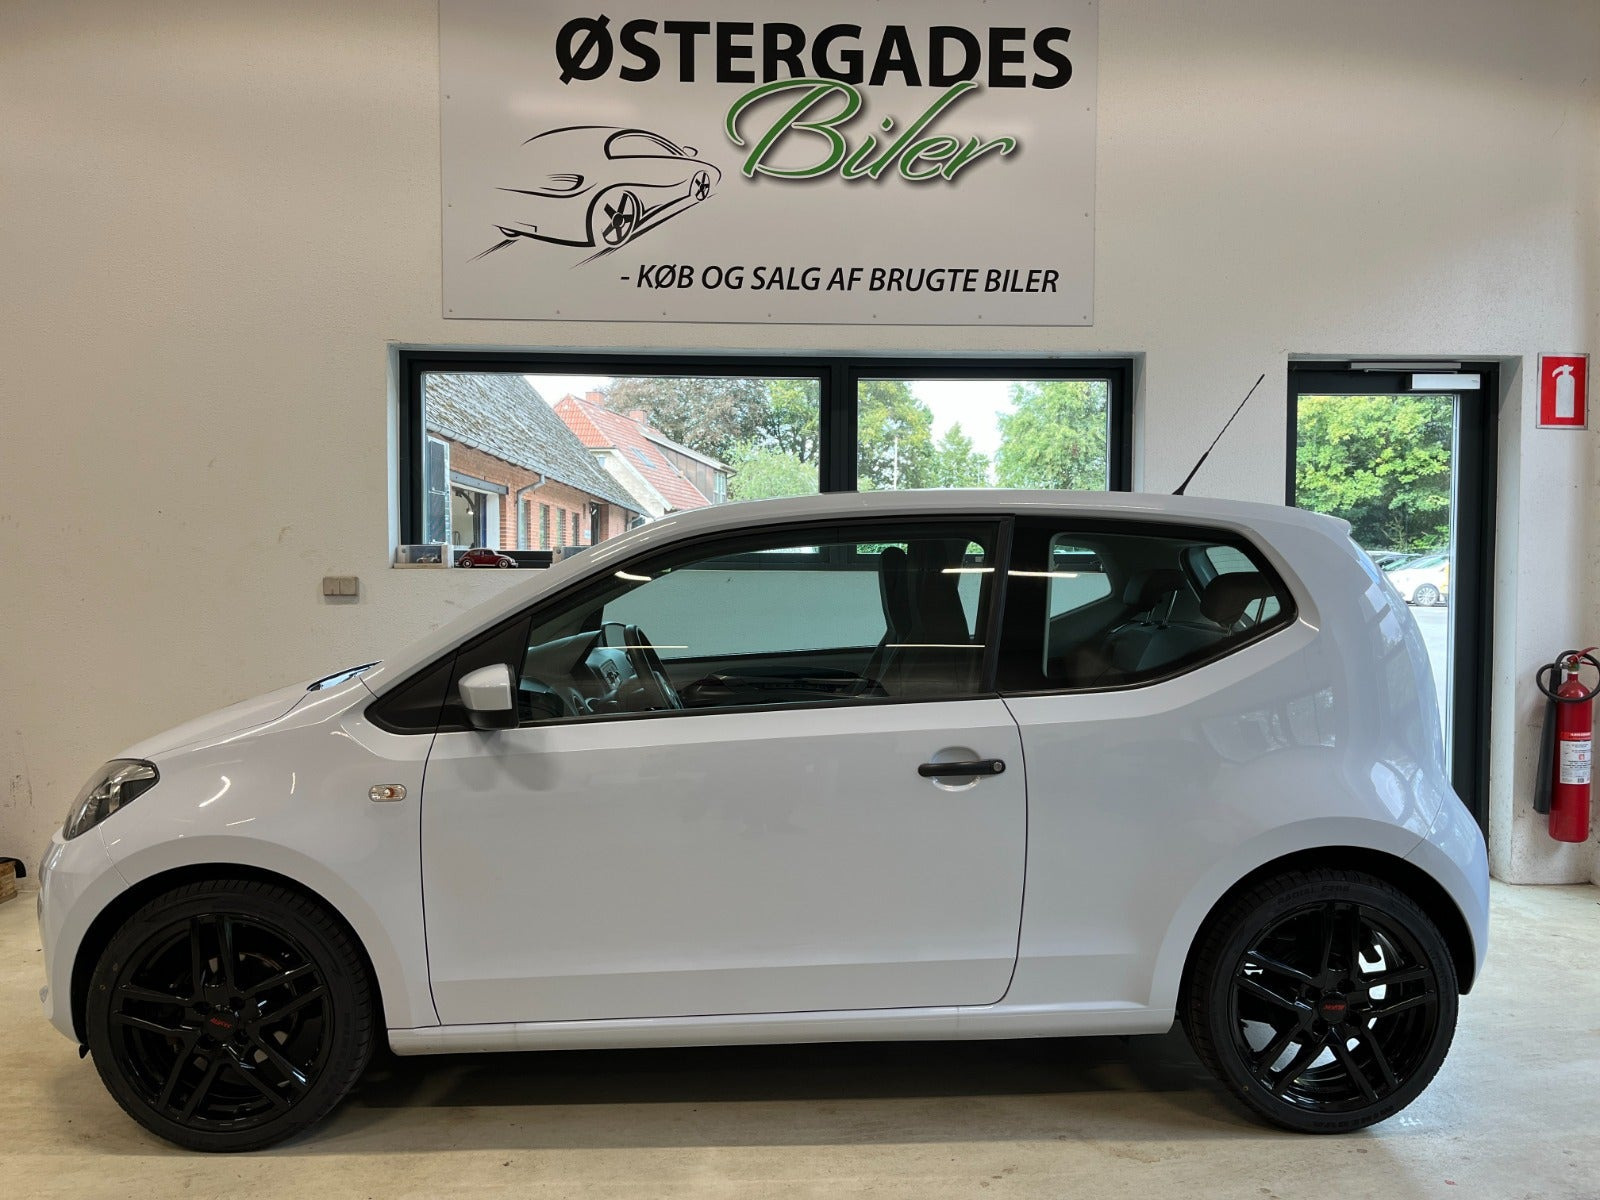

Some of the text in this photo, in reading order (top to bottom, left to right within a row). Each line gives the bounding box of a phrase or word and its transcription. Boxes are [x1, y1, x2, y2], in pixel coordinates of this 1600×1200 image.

[555, 13, 1073, 89] ØSTERGADES
[726, 78, 1016, 181] Biler
[637, 264, 694, 289] KØB
[702, 266, 744, 289] OG
[751, 267, 821, 290] SALG
[826, 268, 863, 290] AF
[869, 268, 979, 292] BRUGTE
[984, 269, 1059, 292] BILER
